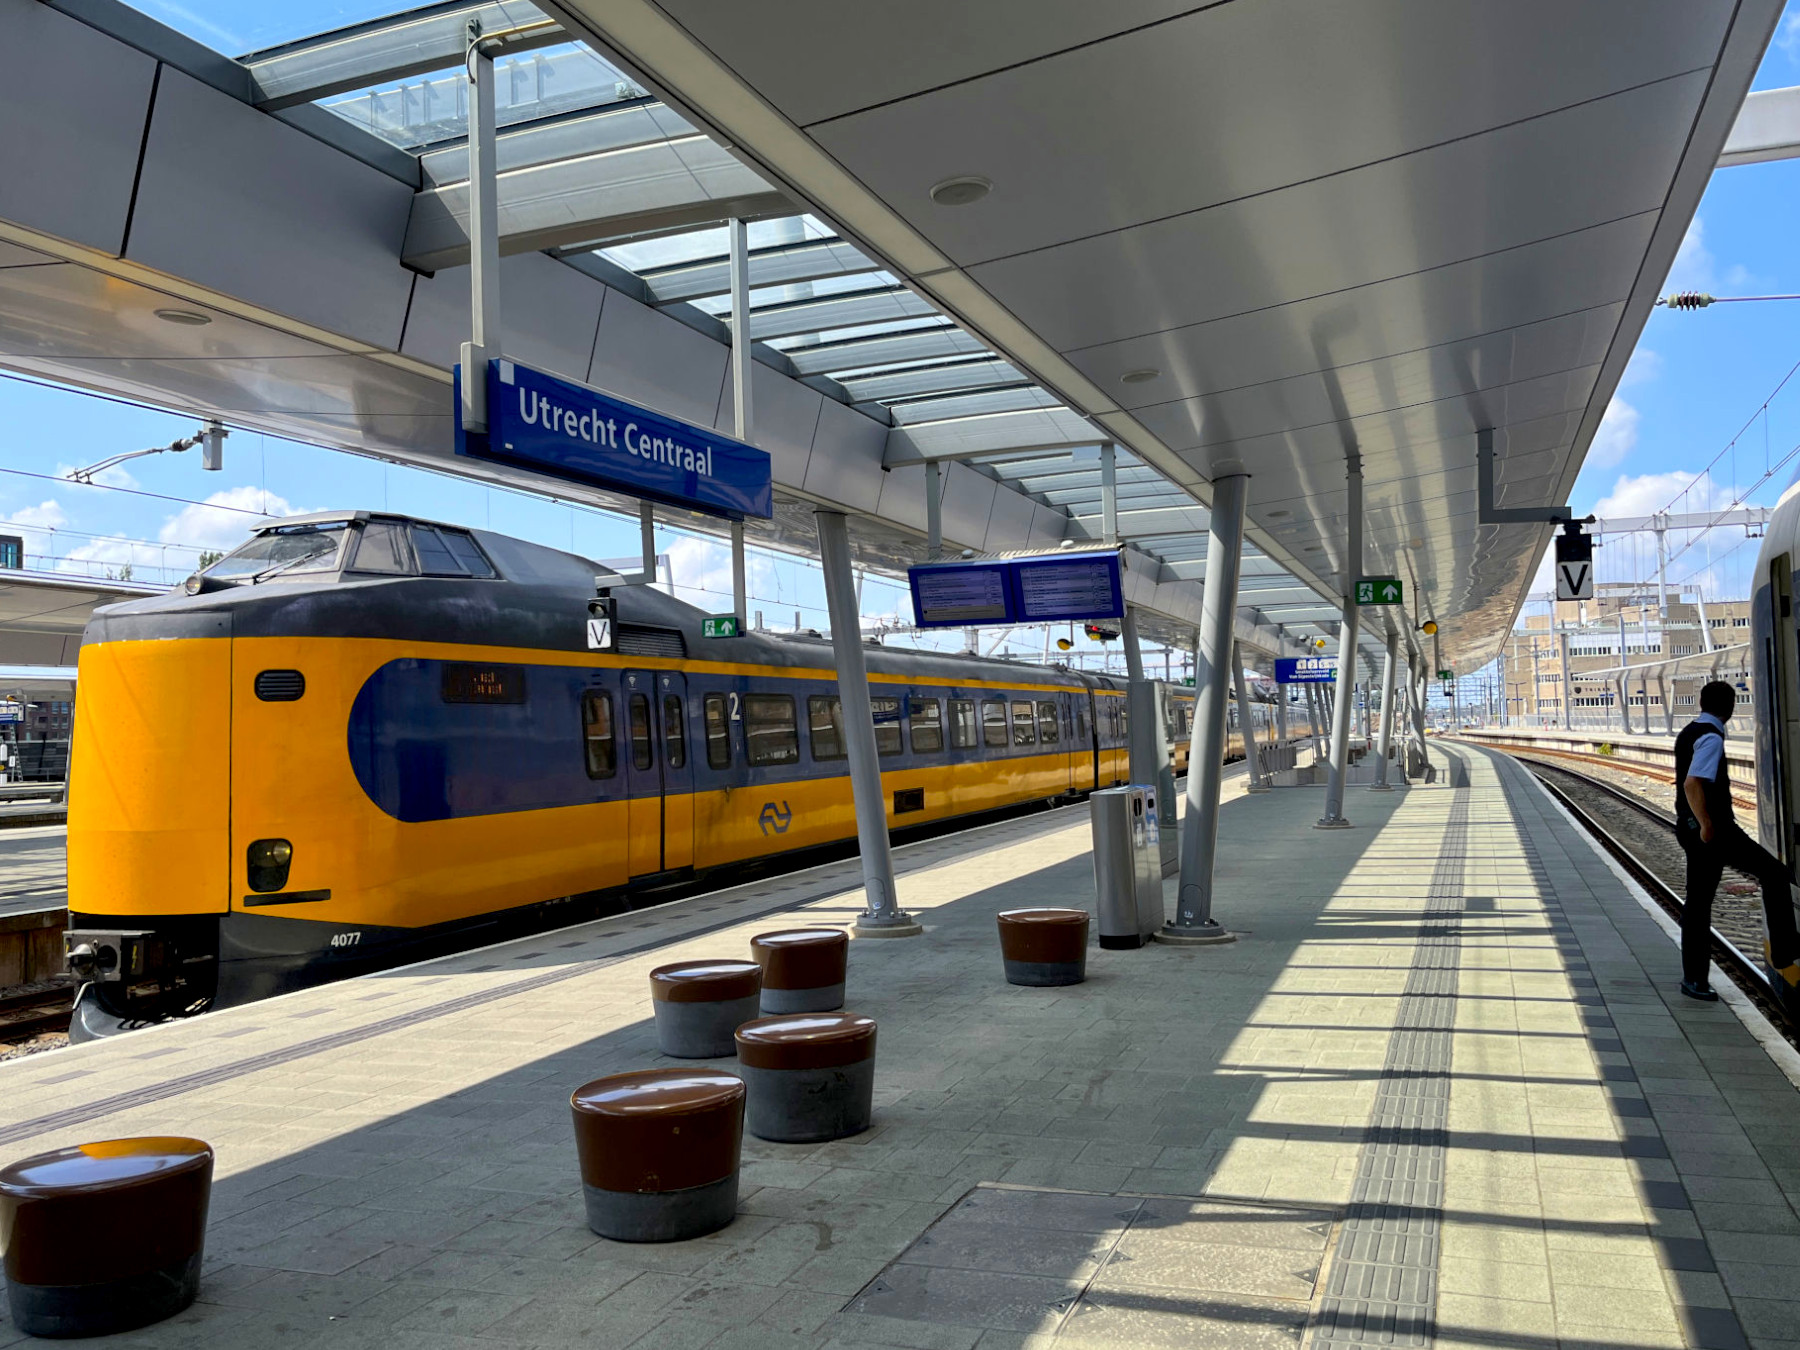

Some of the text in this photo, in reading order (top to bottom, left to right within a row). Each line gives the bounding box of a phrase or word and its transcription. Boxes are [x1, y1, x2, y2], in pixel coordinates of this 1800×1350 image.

[519, 387, 713, 477] Utrecht Centraal
[1561, 564, 1588, 596] V
[591, 621, 607, 645] V
[729, 692, 741, 721] 2
[331, 932, 361, 948] 4077
